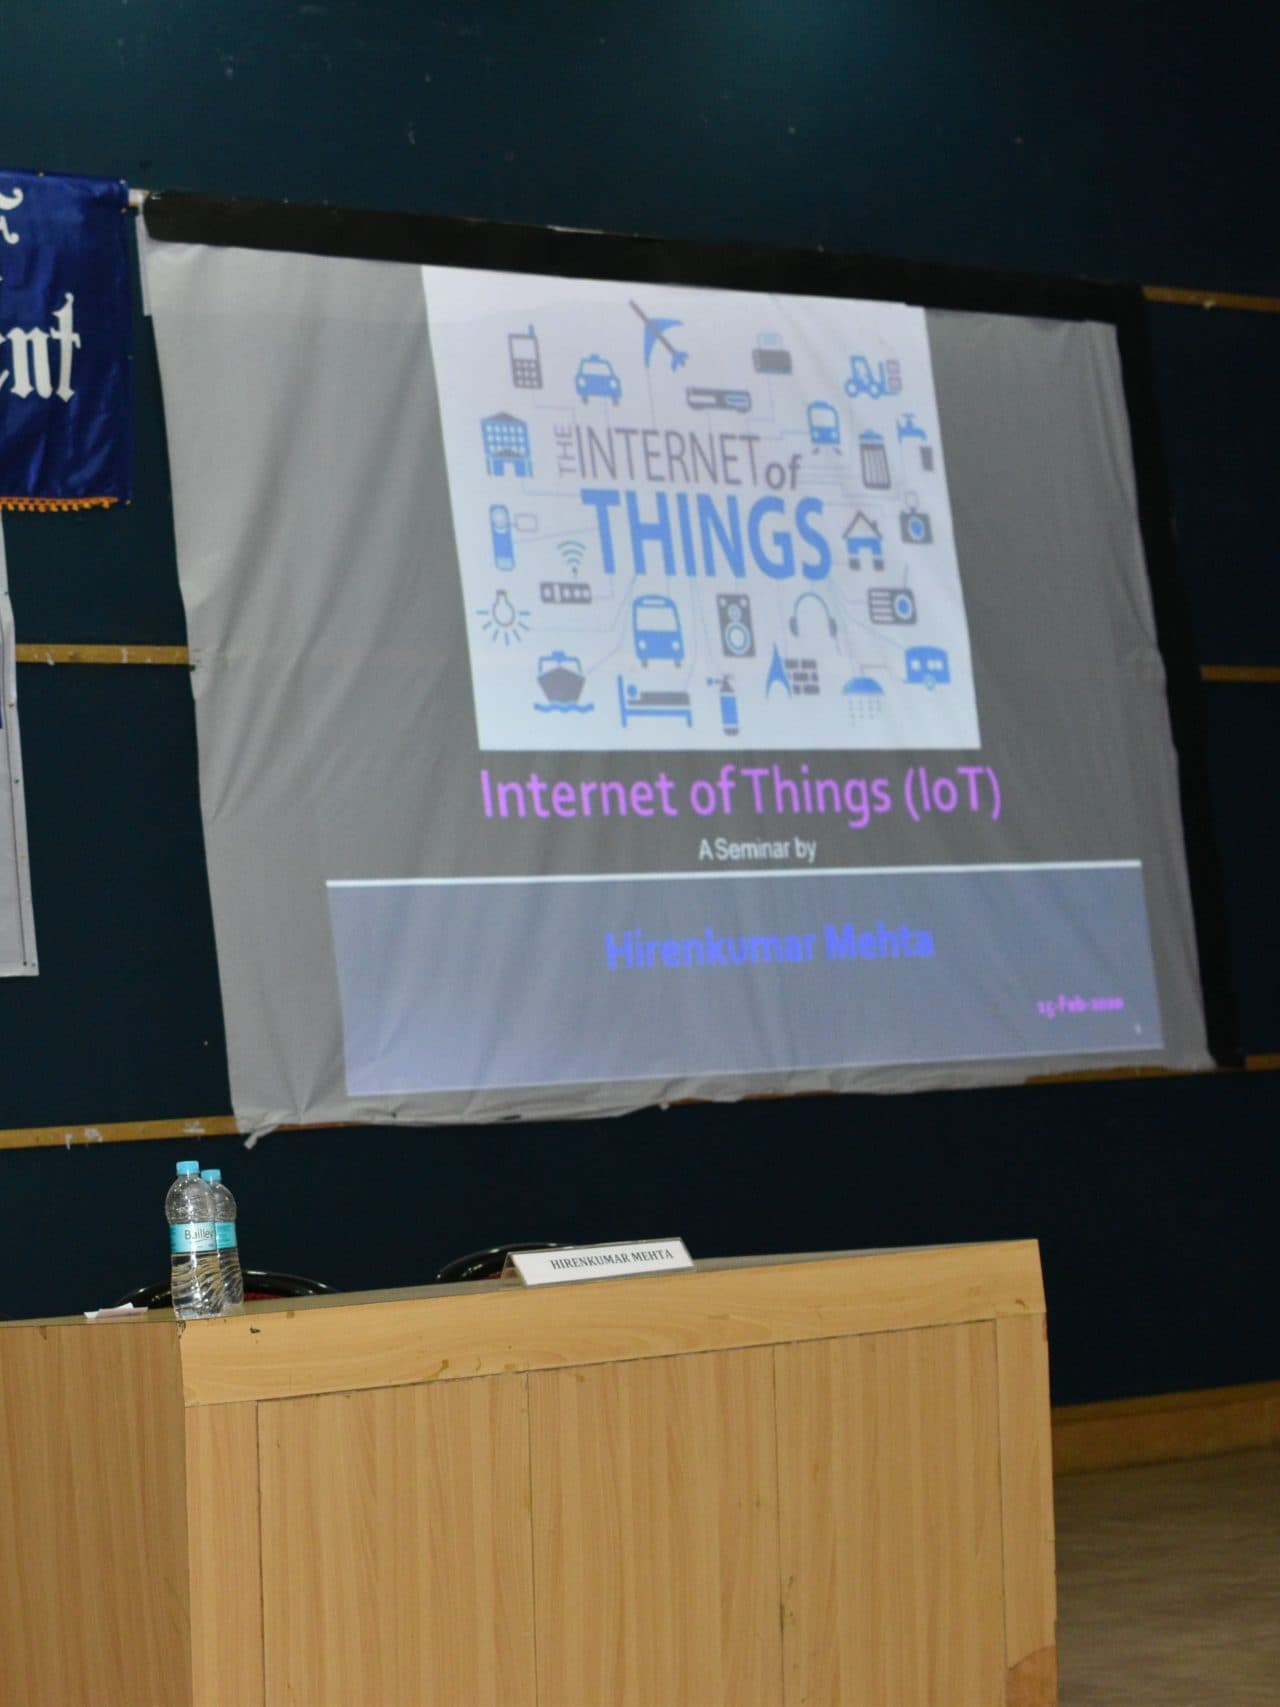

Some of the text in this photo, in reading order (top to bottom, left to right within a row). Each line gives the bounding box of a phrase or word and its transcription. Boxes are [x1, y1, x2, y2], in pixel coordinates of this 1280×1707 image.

[553, 423, 577, 478] THE
[575, 424, 802, 491] INTERNET of
[580, 488, 832, 581] THINGS
[480, 764, 1002, 829] Internet of Things (IoT)
[698, 837, 818, 863] A Seminar by
[604, 921, 935, 970] Hirenkumar Mehta
[550, 1249, 674, 1270] HIRENKUMAR MEHTA
